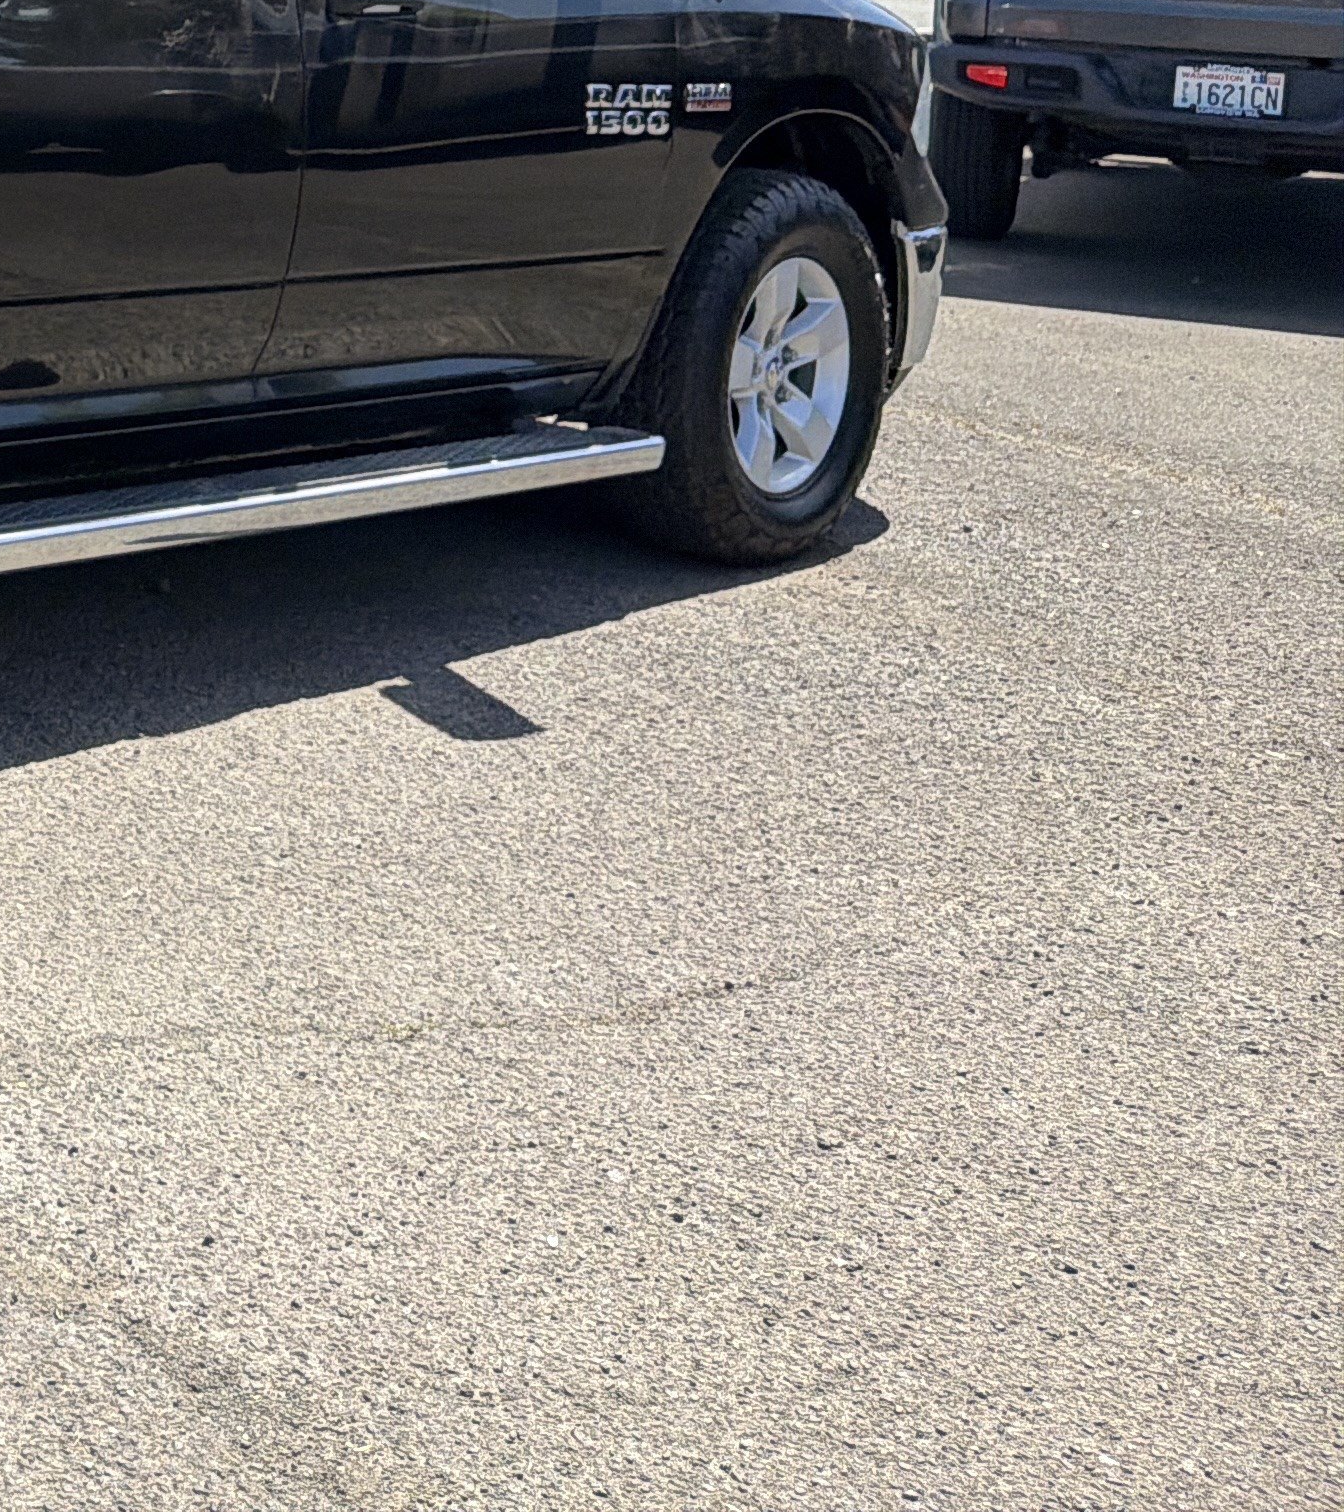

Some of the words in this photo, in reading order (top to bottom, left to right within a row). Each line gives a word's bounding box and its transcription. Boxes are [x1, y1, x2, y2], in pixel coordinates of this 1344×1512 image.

[585, 83, 672, 108] RAM
[1196, 82, 1279, 111] 1621CN
[585, 110, 670, 135] 1500
